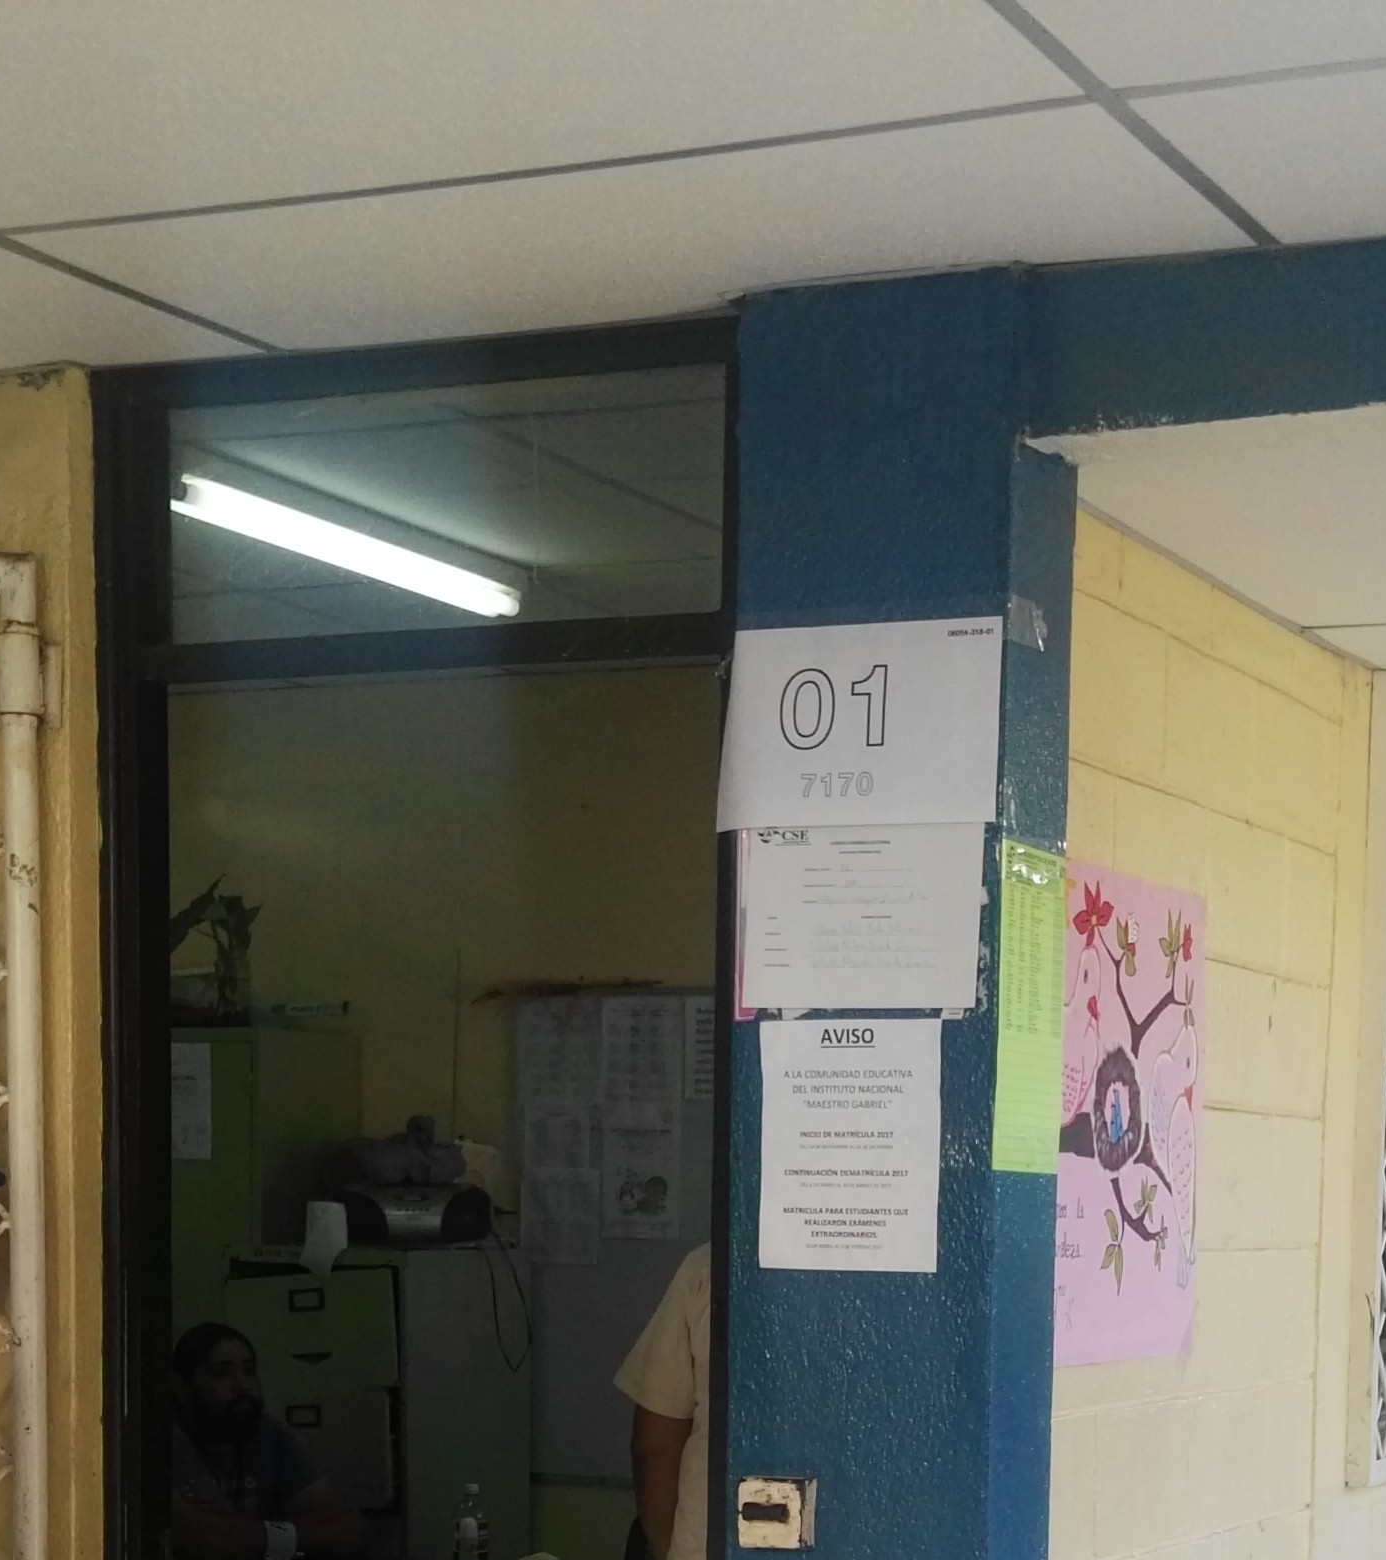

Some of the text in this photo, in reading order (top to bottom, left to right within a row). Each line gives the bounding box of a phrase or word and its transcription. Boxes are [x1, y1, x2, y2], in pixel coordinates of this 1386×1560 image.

[779, 664, 888, 750] 01
[800, 771, 873, 798] 7170
[782, 829, 809, 841] CSE
[820, 1028, 875, 1045] AVISO
[783, 1070, 913, 1079] A LA COMUNIDAD EDUCATIVA
[792, 1085, 904, 1094] DEL INSTITUTO NACIONAL
[803, 1100, 892, 1109] "MAESTRO GABRIEL"
[825, 1207, 844, 1215] PARA
[845, 1207, 892, 1215] ESTUDIANTES
[893, 1208, 909, 1216] QUE
